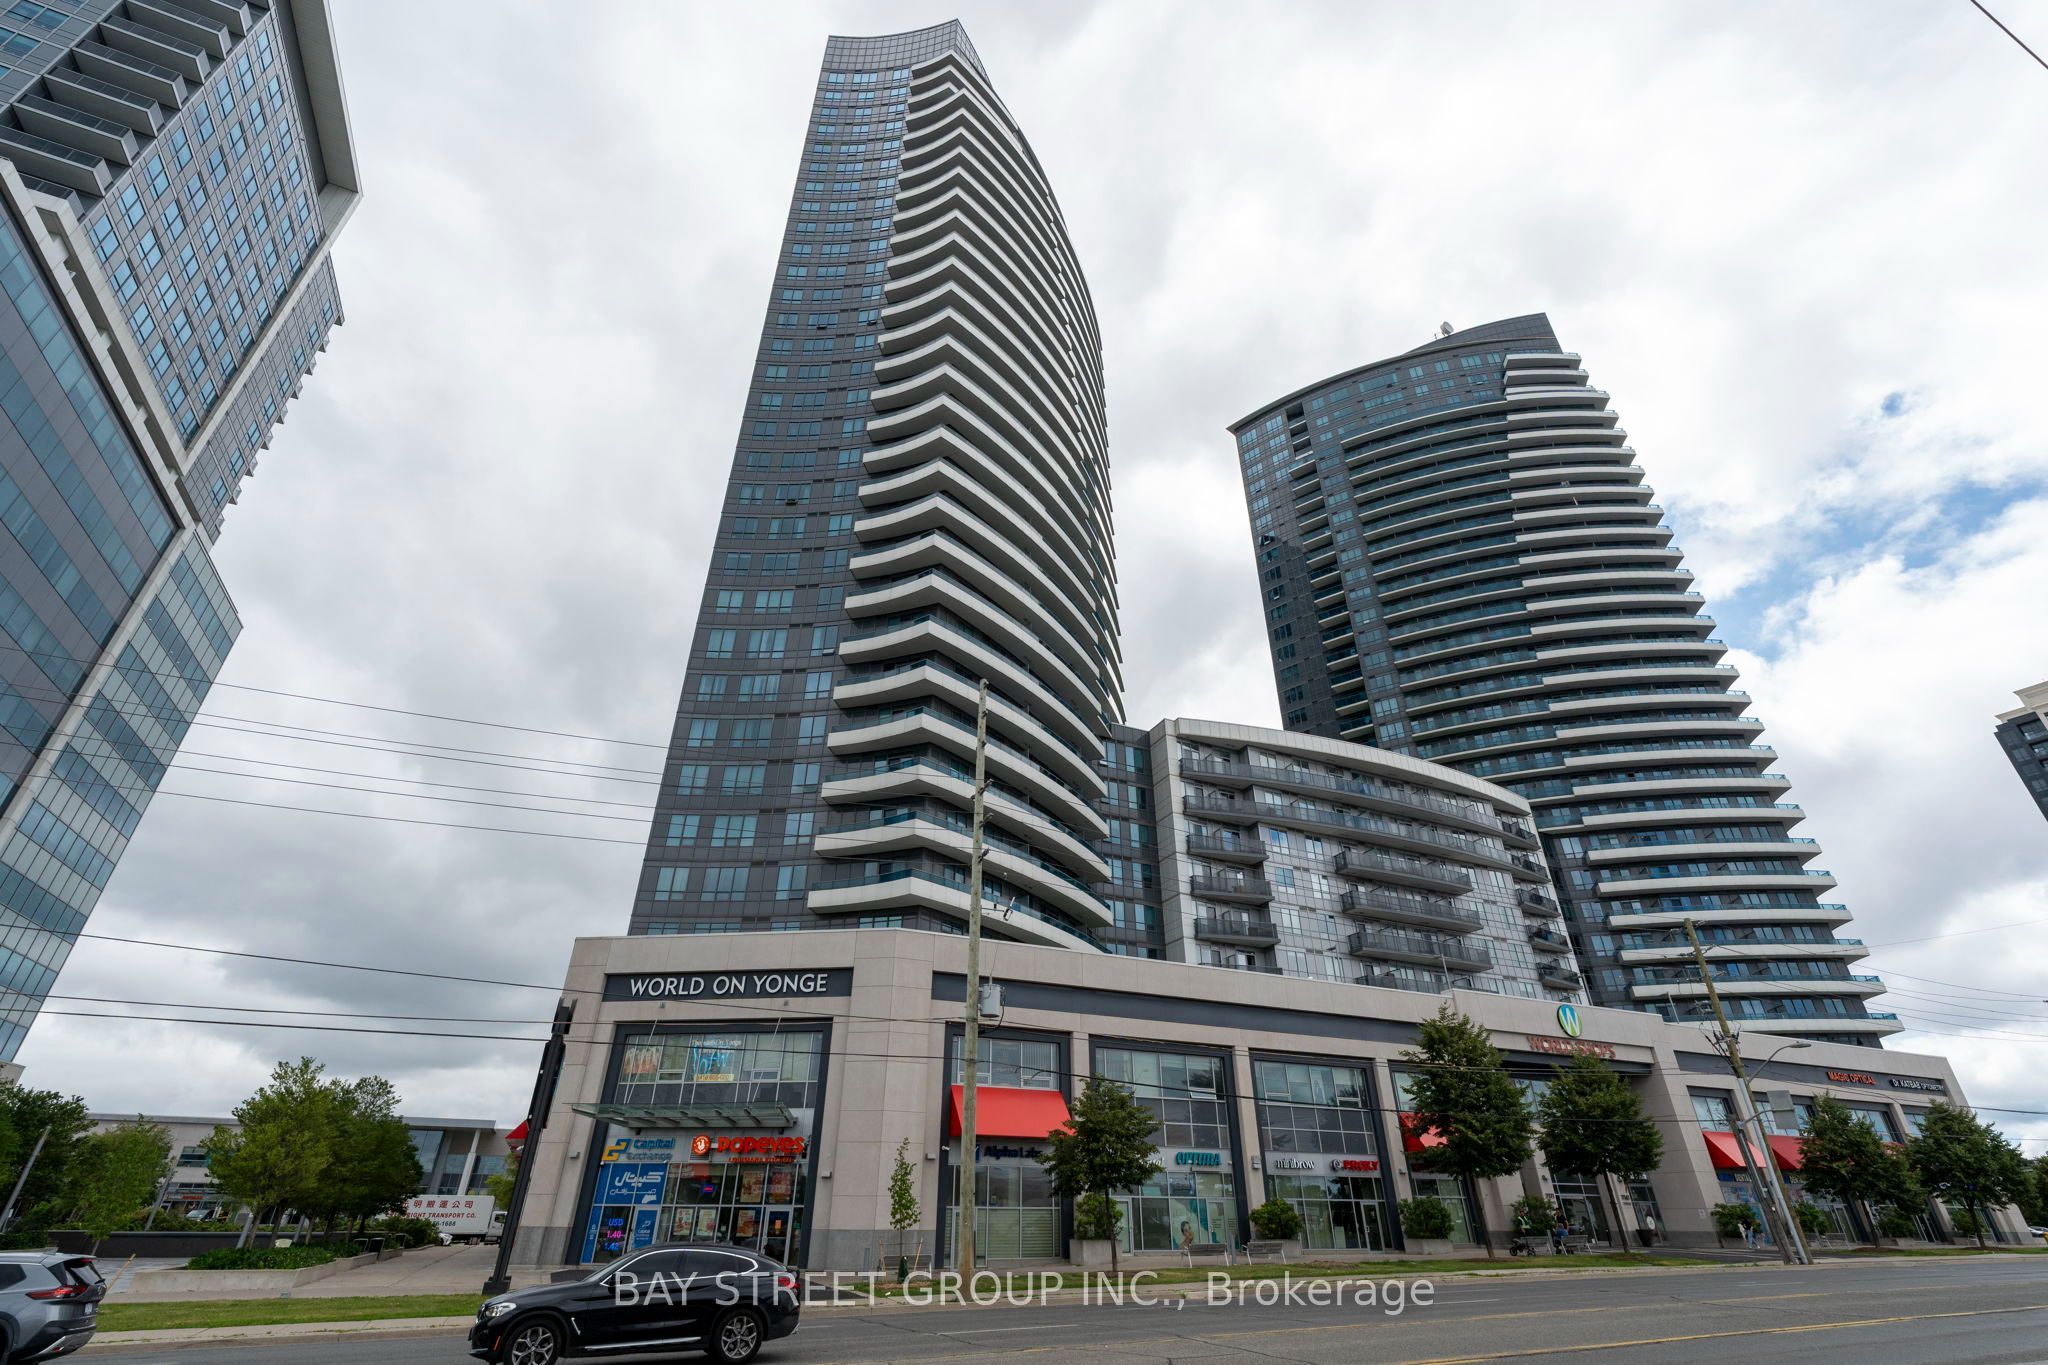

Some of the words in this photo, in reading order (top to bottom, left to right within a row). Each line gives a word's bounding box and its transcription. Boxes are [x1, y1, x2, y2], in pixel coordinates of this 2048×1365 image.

[630, 977, 705, 997] WORLD
[712, 975, 746, 995] ON
[752, 973, 828, 994] YONGE
[1527, 1035, 1574, 1056] WORLD
[1575, 1039, 1617, 1059] SHOPS
[1827, 1071, 1850, 1083] MAGIC
[1849, 1074, 1877, 1086] OPTICAL
[633, 1138, 674, 1151] Capital
[984, 1145, 1019, 1160] Alpha
[608, 1218, 624, 1226] USD
[606, 1230, 622, 1239] 1.40
